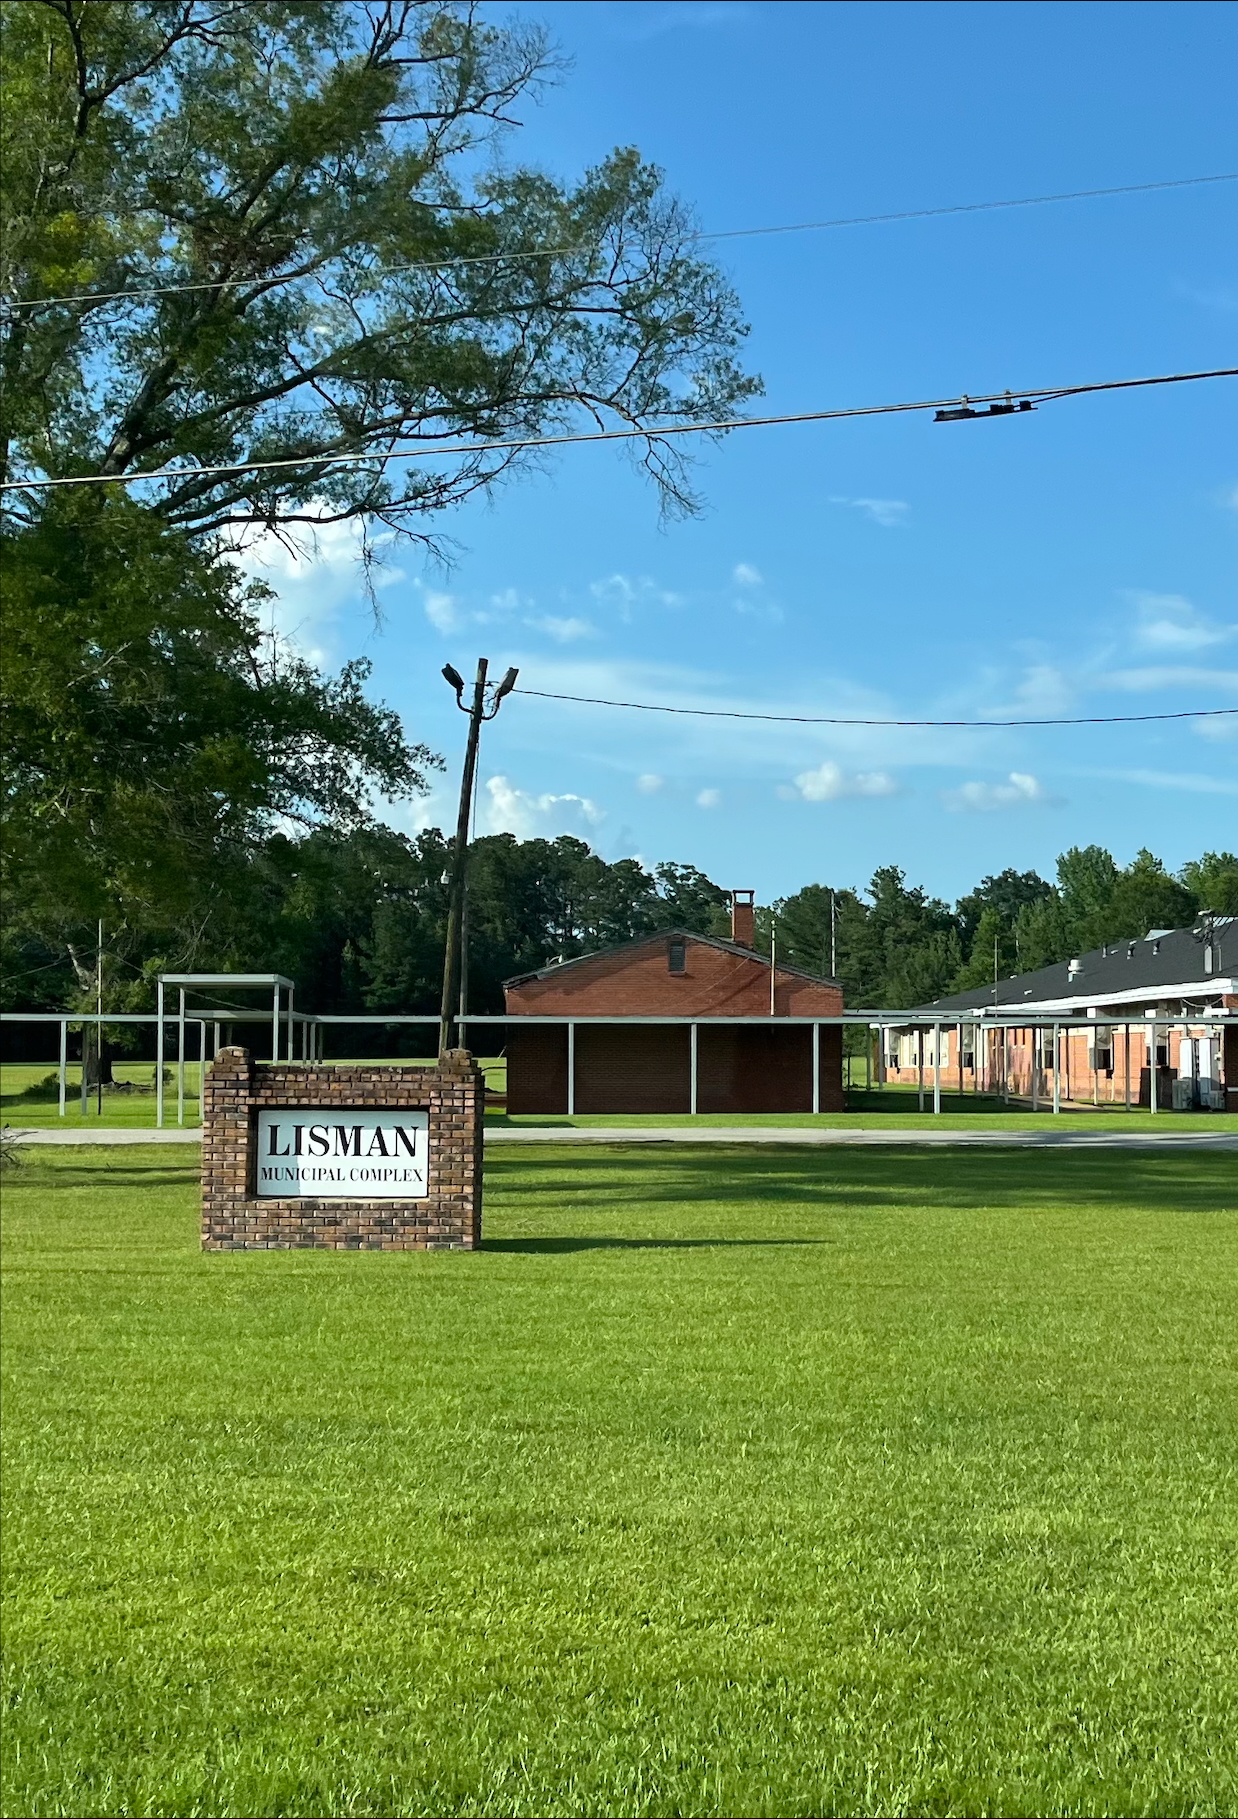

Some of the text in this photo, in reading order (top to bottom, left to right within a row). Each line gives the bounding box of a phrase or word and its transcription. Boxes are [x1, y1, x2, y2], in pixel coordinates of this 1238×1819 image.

[266, 1124, 419, 1157] LISMAN
[260, 1167, 423, 1182] MUNICIPAL COMPLEX
